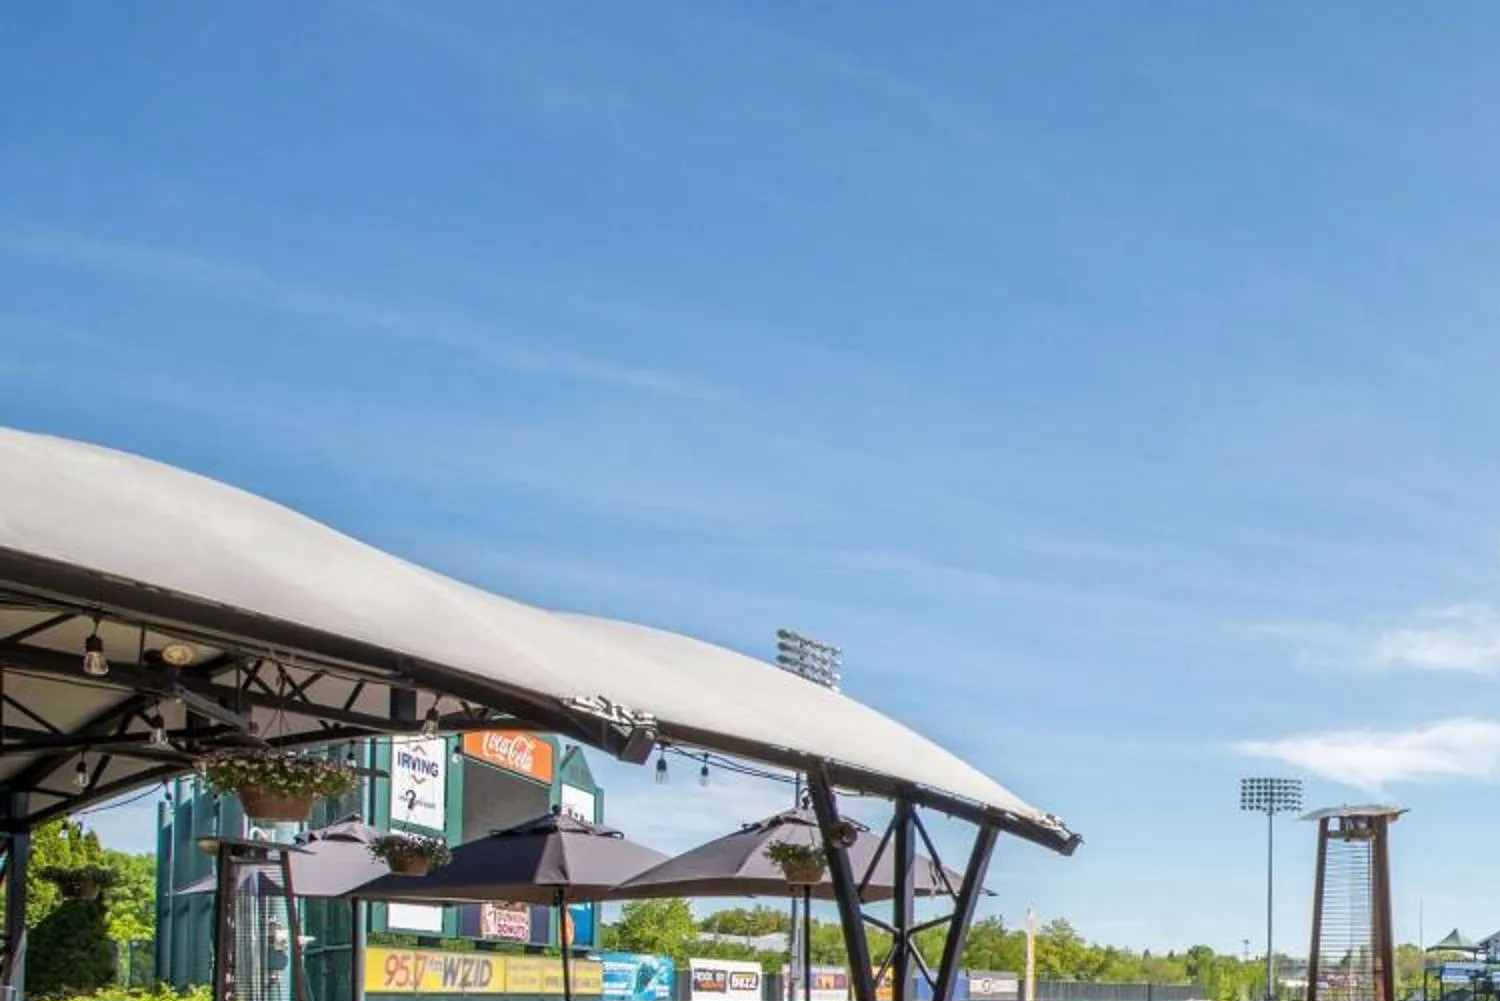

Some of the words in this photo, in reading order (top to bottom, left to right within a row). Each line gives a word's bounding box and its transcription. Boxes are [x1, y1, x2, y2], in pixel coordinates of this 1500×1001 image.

[397, 751, 439, 778] IRVING
[384, 953, 428, 988] 95.7
[442, 956, 493, 988] WZID
